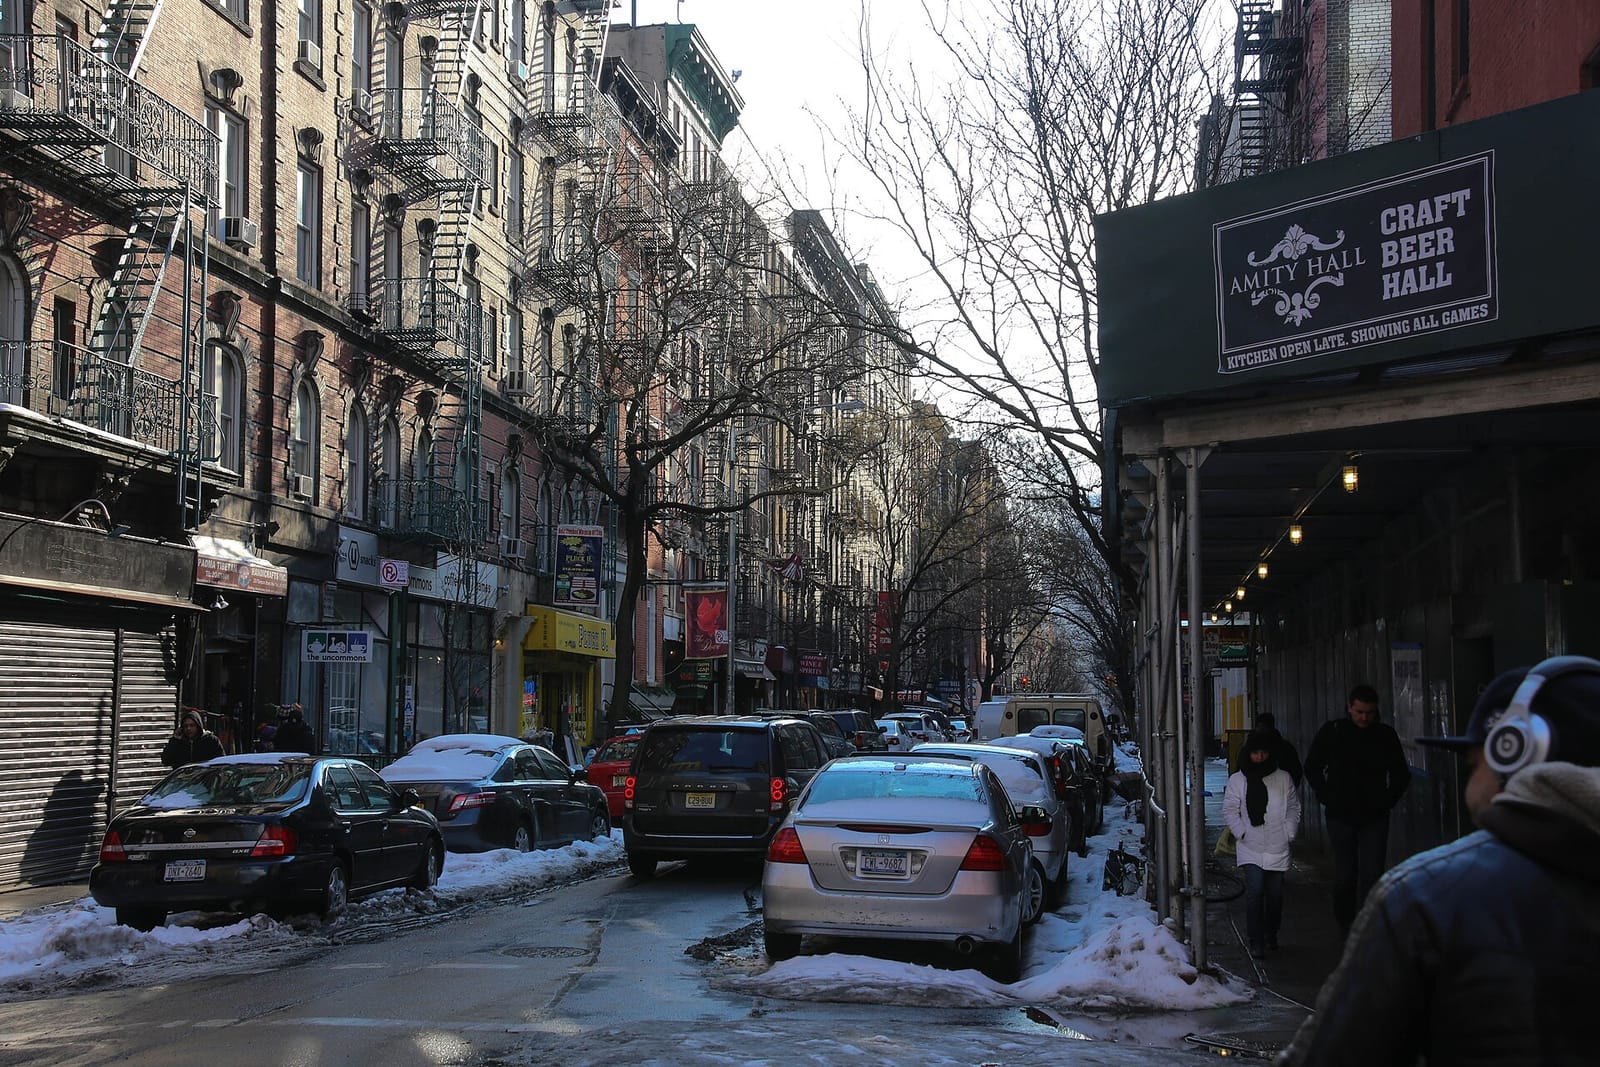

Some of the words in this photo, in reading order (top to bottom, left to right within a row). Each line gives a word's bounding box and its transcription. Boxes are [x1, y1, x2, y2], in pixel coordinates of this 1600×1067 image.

[1380, 187, 1471, 236] CRAFT
[1381, 226, 1455, 269] BEER
[1229, 262, 1299, 296] AMITY
[1307, 246, 1367, 277] HALL
[1382, 260, 1453, 301] HALL
[1226, 347, 1278, 370] KITCHEN
[1280, 341, 1312, 359] OPEN
[1351, 320, 1411, 344] SHOWING
[1412, 315, 1440, 331] ALL
[1441, 303, 1490, 326] GAMES
[307, 653, 320, 661] the
[322, 654, 367, 662] uncommons
